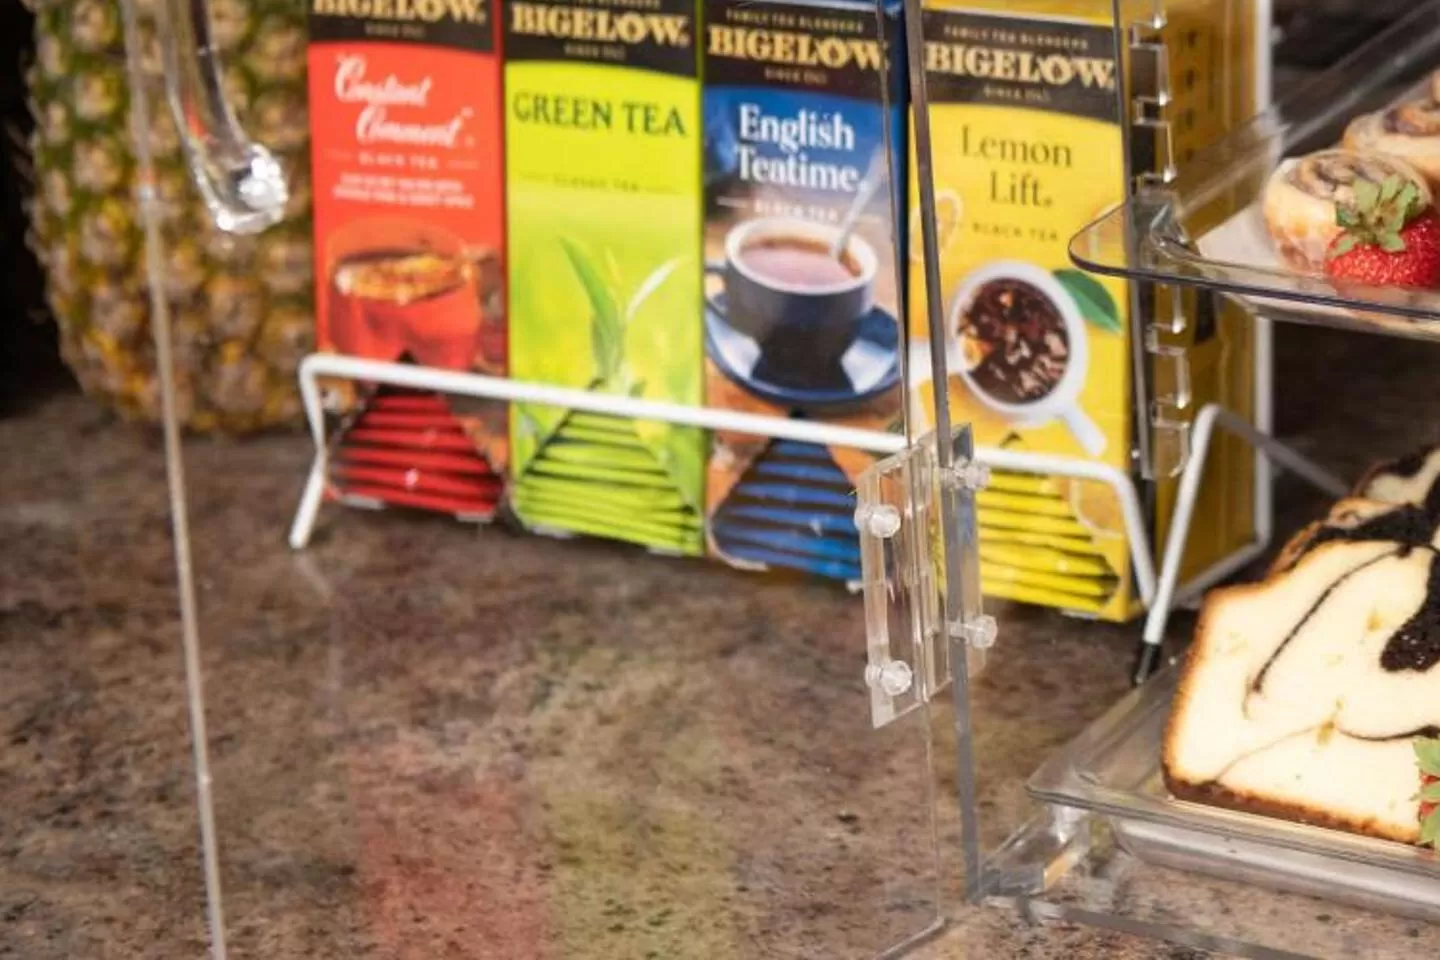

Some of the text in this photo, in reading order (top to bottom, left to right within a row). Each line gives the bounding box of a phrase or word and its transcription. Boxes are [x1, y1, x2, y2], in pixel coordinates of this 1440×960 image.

[511, 1, 689, 47] BIGELOW
[707, 24, 888, 71] BIGELOW
[924, 41, 1116, 90] BIGELOW
[512, 89, 687, 139] GREEN TEA
[739, 102, 856, 153] English
[962, 123, 1073, 169] Lemon
[1029, 227, 1058, 242] TEA
